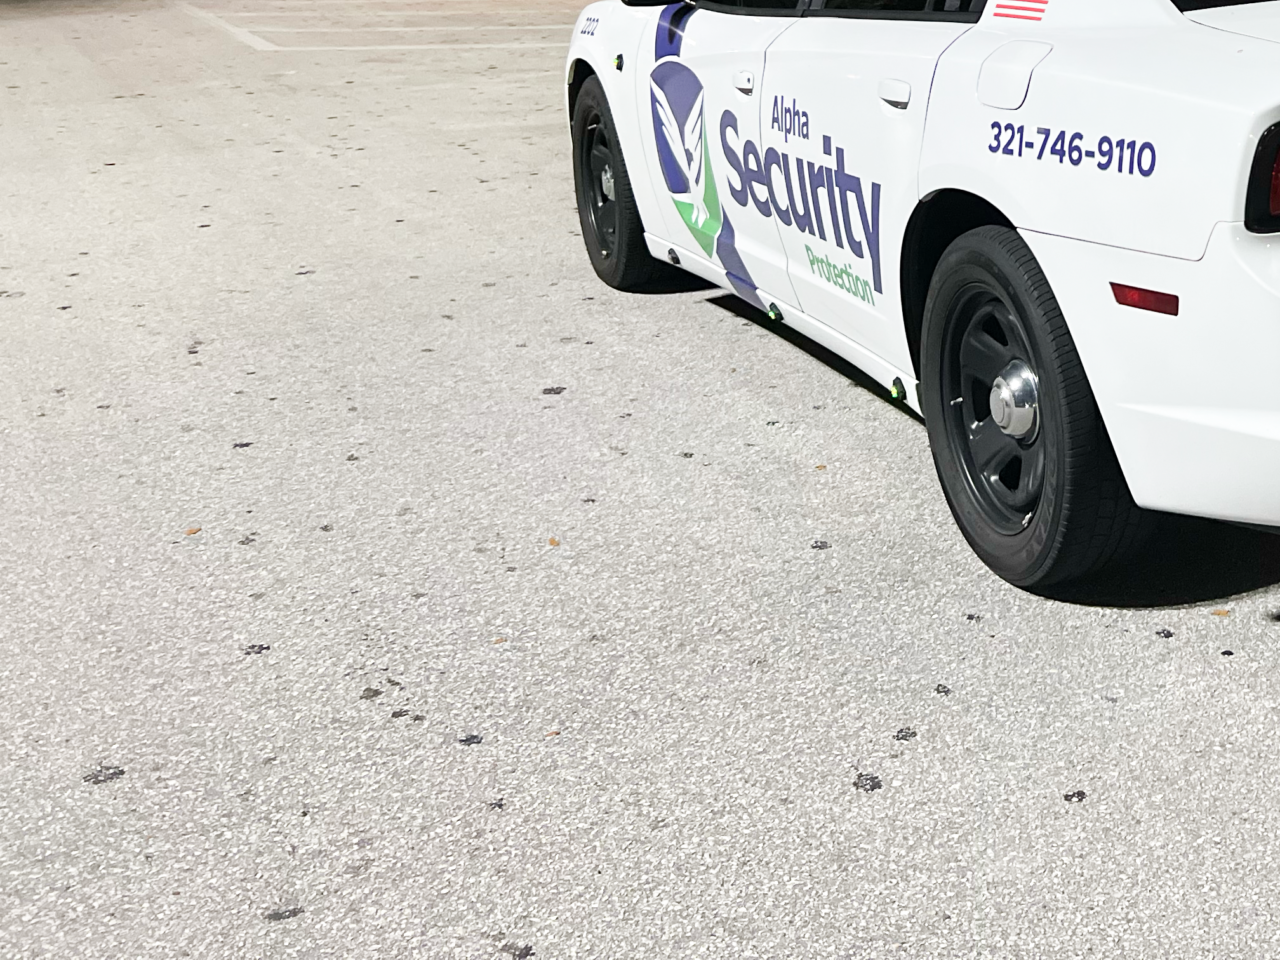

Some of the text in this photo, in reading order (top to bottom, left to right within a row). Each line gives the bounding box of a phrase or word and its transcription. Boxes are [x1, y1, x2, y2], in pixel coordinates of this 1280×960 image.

[771, 95, 810, 143] Alpha
[988, 120, 1156, 178] 321-746-9110
[719, 109, 883, 295] Security
[804, 243, 876, 307] Protection
